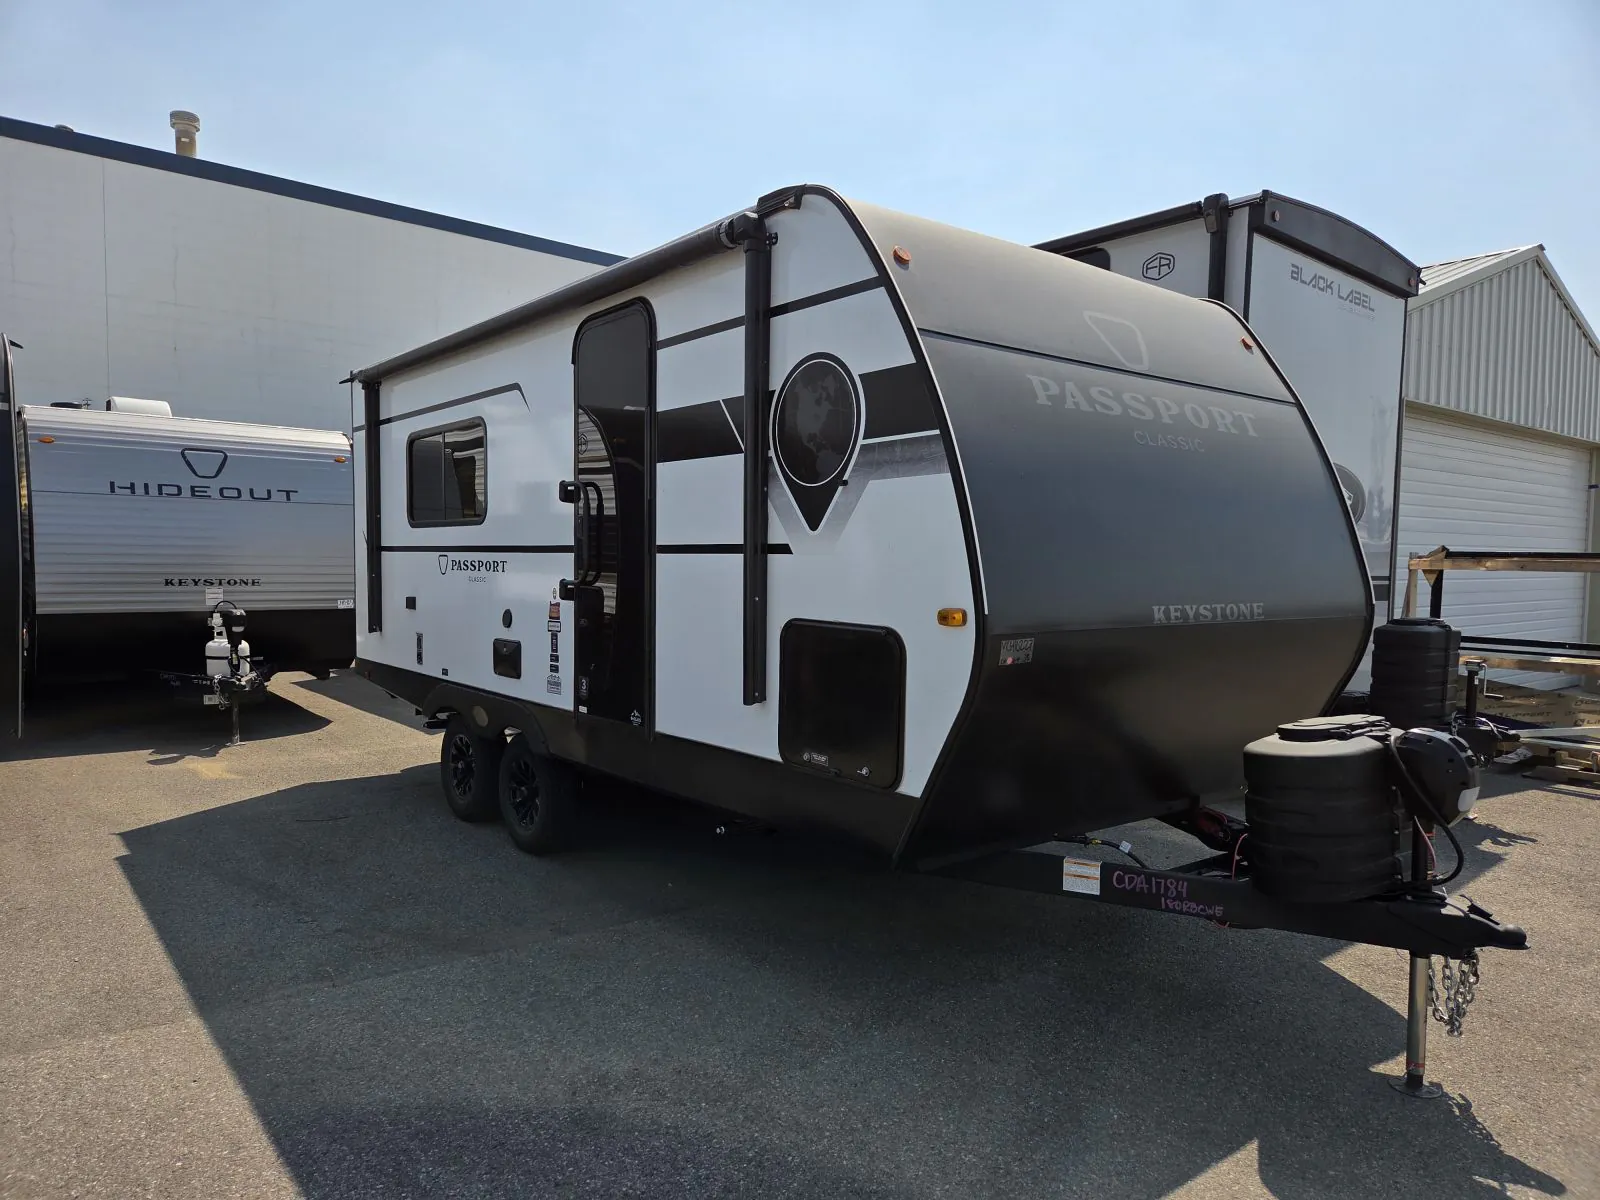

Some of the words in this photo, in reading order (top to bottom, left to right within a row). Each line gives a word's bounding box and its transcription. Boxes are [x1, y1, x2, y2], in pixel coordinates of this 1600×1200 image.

[1290, 263, 1334, 296] BLACK
[1337, 283, 1375, 313] LABEL
[1026, 373, 1258, 437] PASSPORT
[1133, 430, 1205, 452] CLASSIC
[109, 480, 299, 502] HIDEOUT
[450, 559, 508, 573] PASSPORT
[163, 578, 263, 587] KEYSTONE
[1152, 602, 1265, 624] KEYSTONE
[1112, 870, 1188, 898] CDA1784
